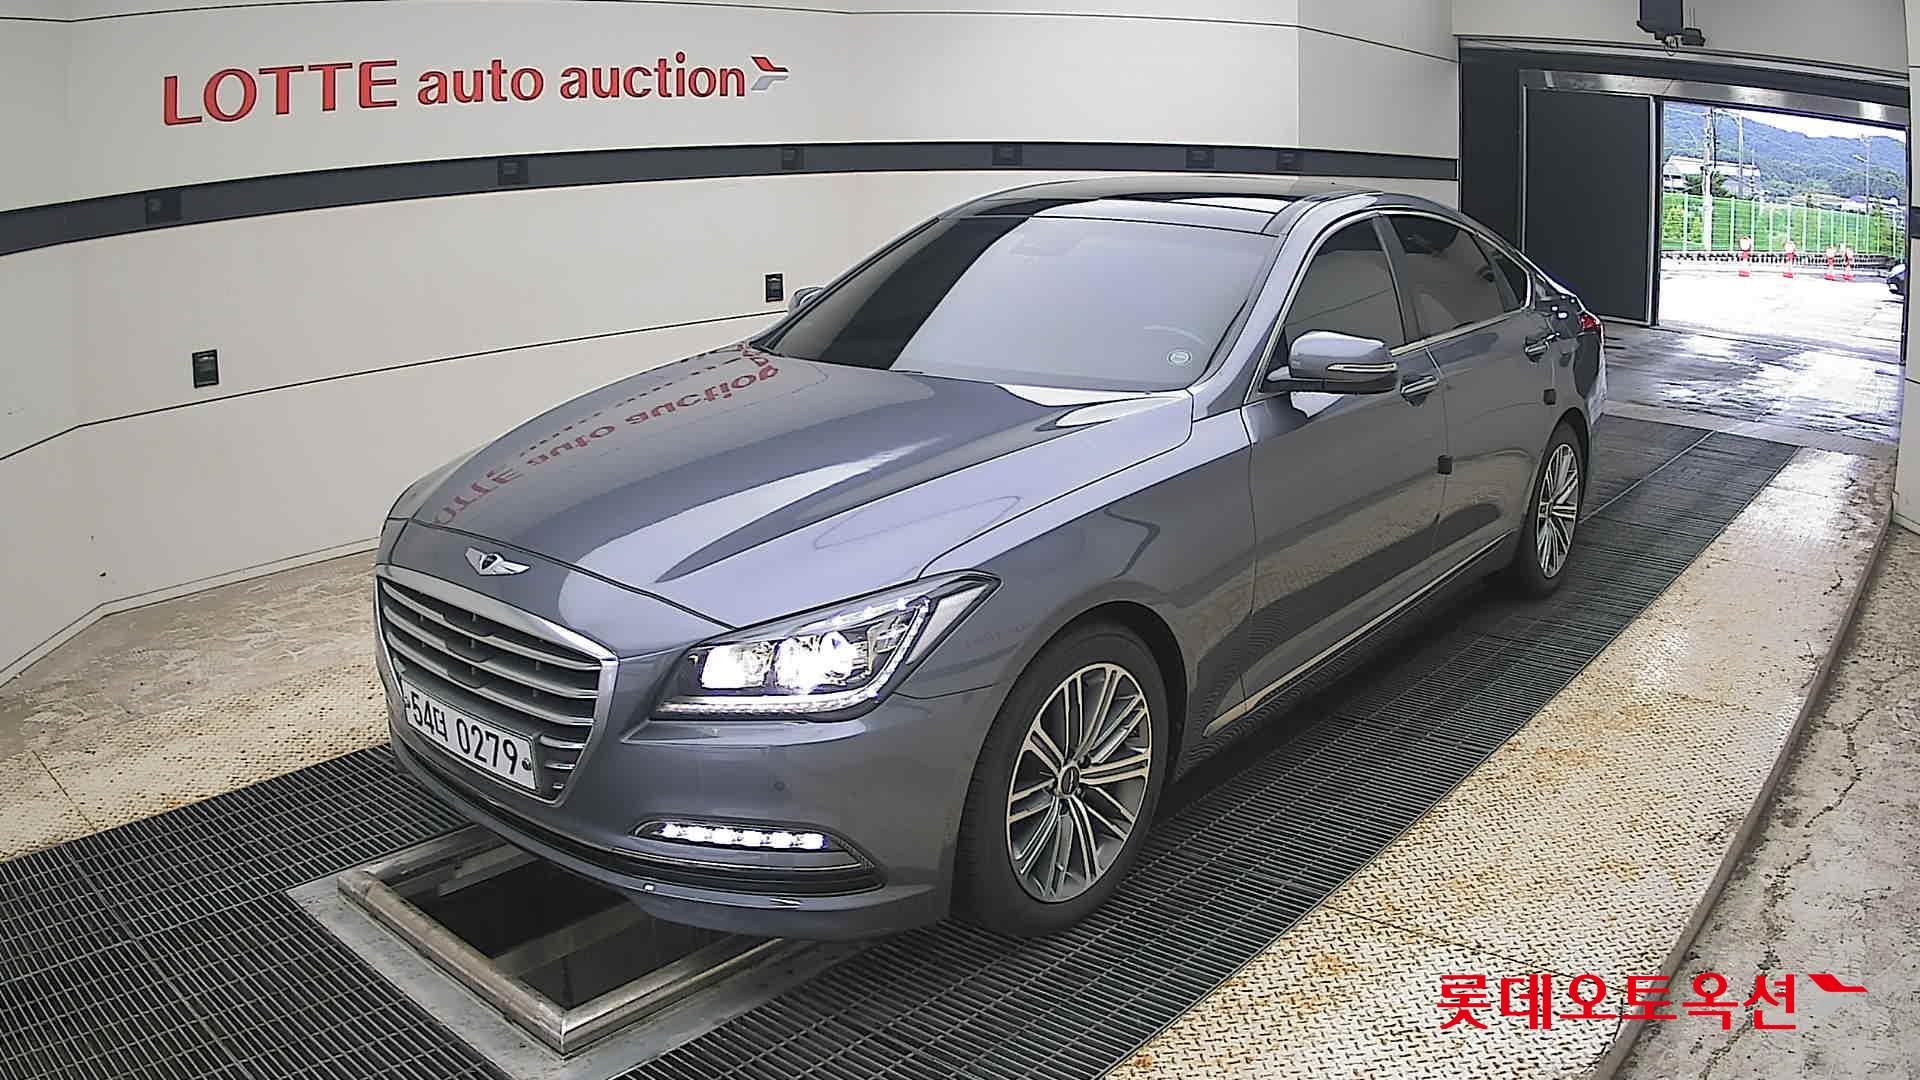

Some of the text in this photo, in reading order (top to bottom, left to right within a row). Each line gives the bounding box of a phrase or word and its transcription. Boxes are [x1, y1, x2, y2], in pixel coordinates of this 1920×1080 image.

[163, 51, 746, 126] LOTTE auto auction
[456, 717, 518, 775] 0279
